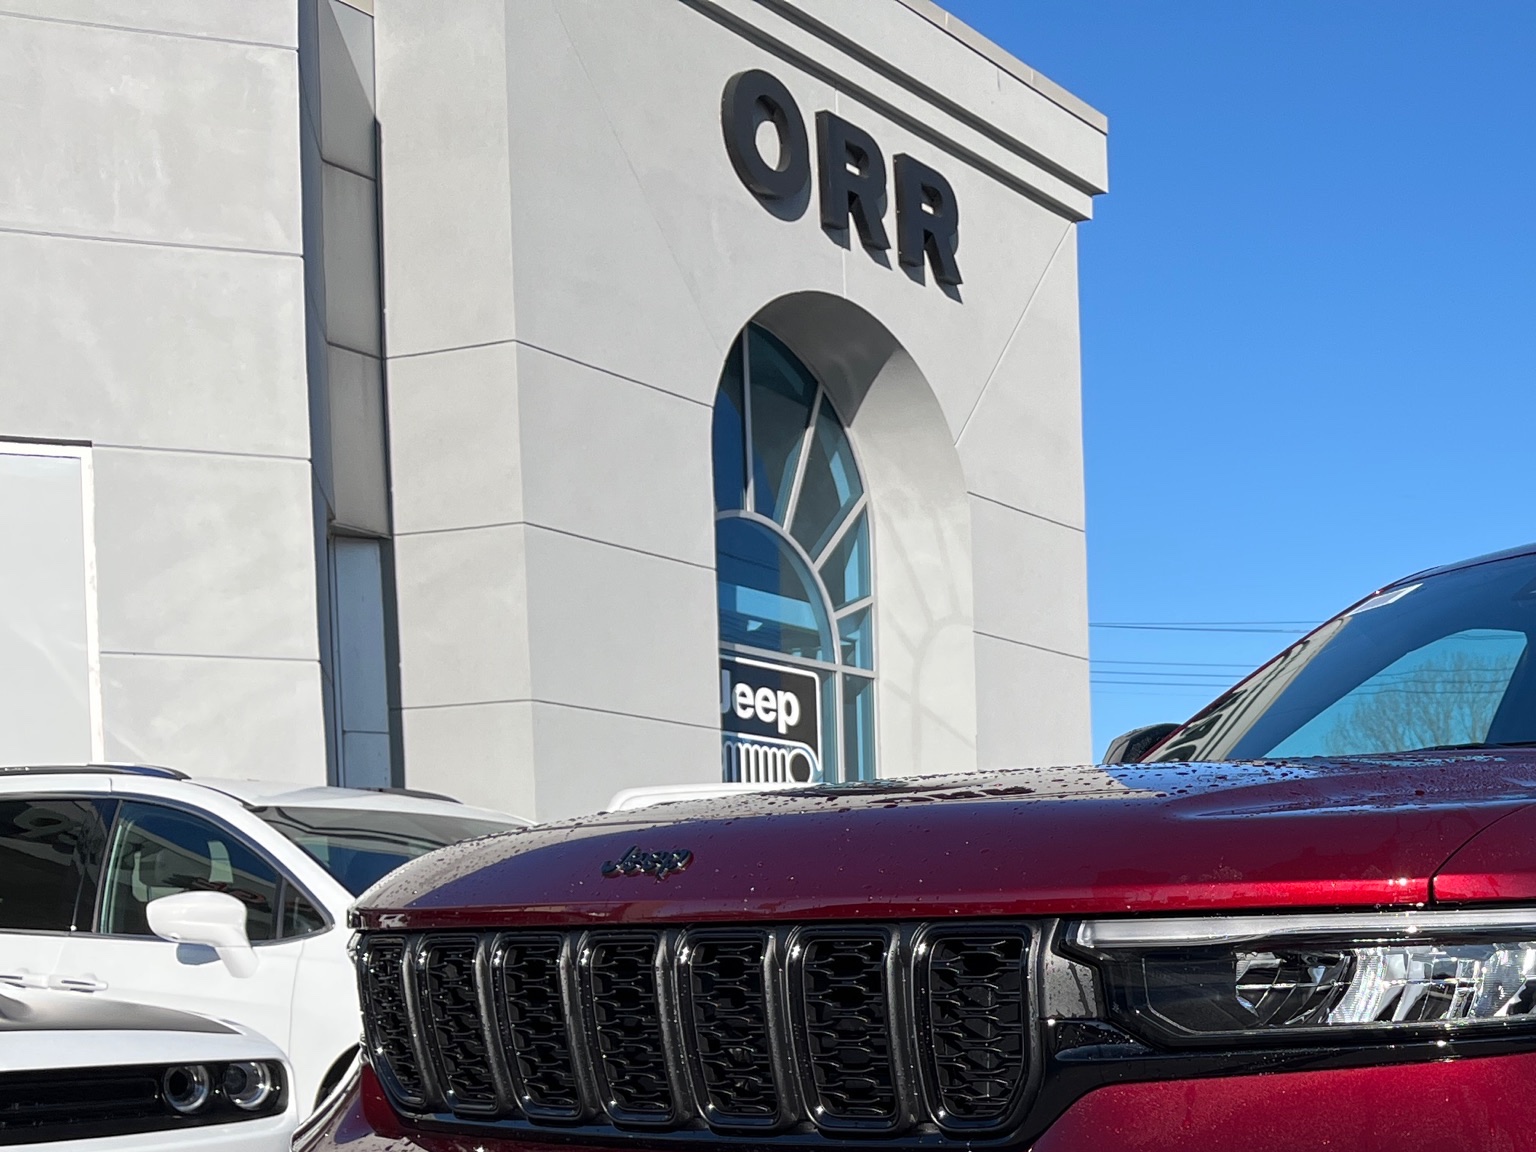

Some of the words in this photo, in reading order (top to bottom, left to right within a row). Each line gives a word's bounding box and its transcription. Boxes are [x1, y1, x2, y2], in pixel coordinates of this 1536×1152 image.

[721, 69, 963, 286] ORR
[721, 669, 800, 735] Jeep
[602, 845, 694, 880] Jeep
